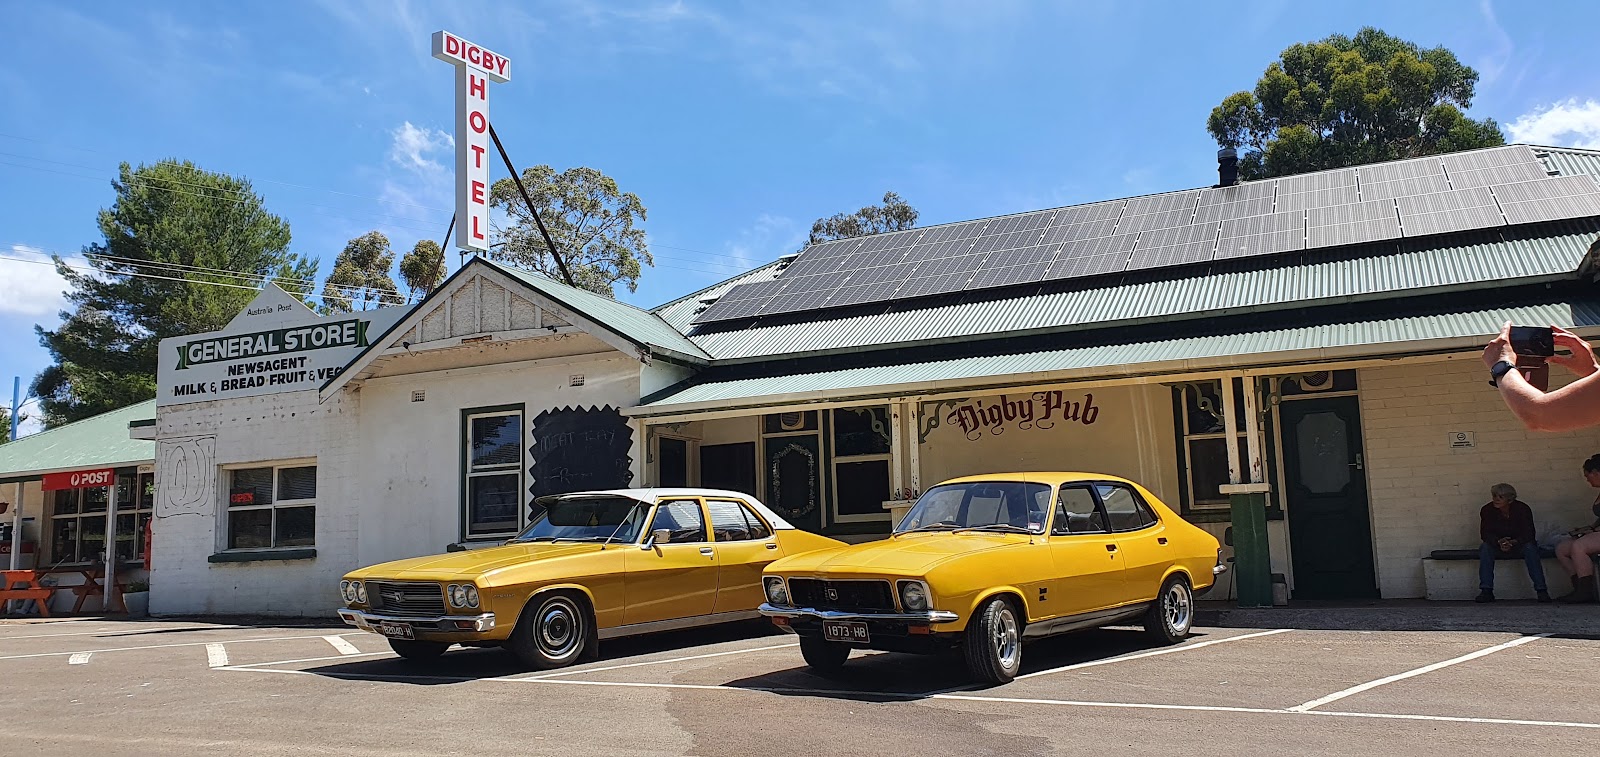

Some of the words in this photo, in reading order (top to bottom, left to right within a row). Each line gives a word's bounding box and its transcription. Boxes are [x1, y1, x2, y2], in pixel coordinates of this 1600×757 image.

[446, 35, 508, 75] DIGBY
[469, 74, 487, 240] HOTEL
[247, 305, 273, 317] Australia
[277, 303, 292, 312] Post
[189, 334, 280, 363] GENERAL
[284, 322, 356, 351] STORE
[228, 356, 307, 377] NEWSAGENT
[174, 382, 207, 397] MILK
[210, 382, 217, 394] &
[220, 376, 265, 392] BREAD
[269, 371, 307, 386] FRUIT
[308, 370, 316, 381] &
[946, 394, 1034, 442] Digby
[1031, 390, 1099, 430] Pub
[540, 431, 576, 452] MEAT
[81, 471, 111, 485] POST
[231, 492, 255, 504] OPEN
